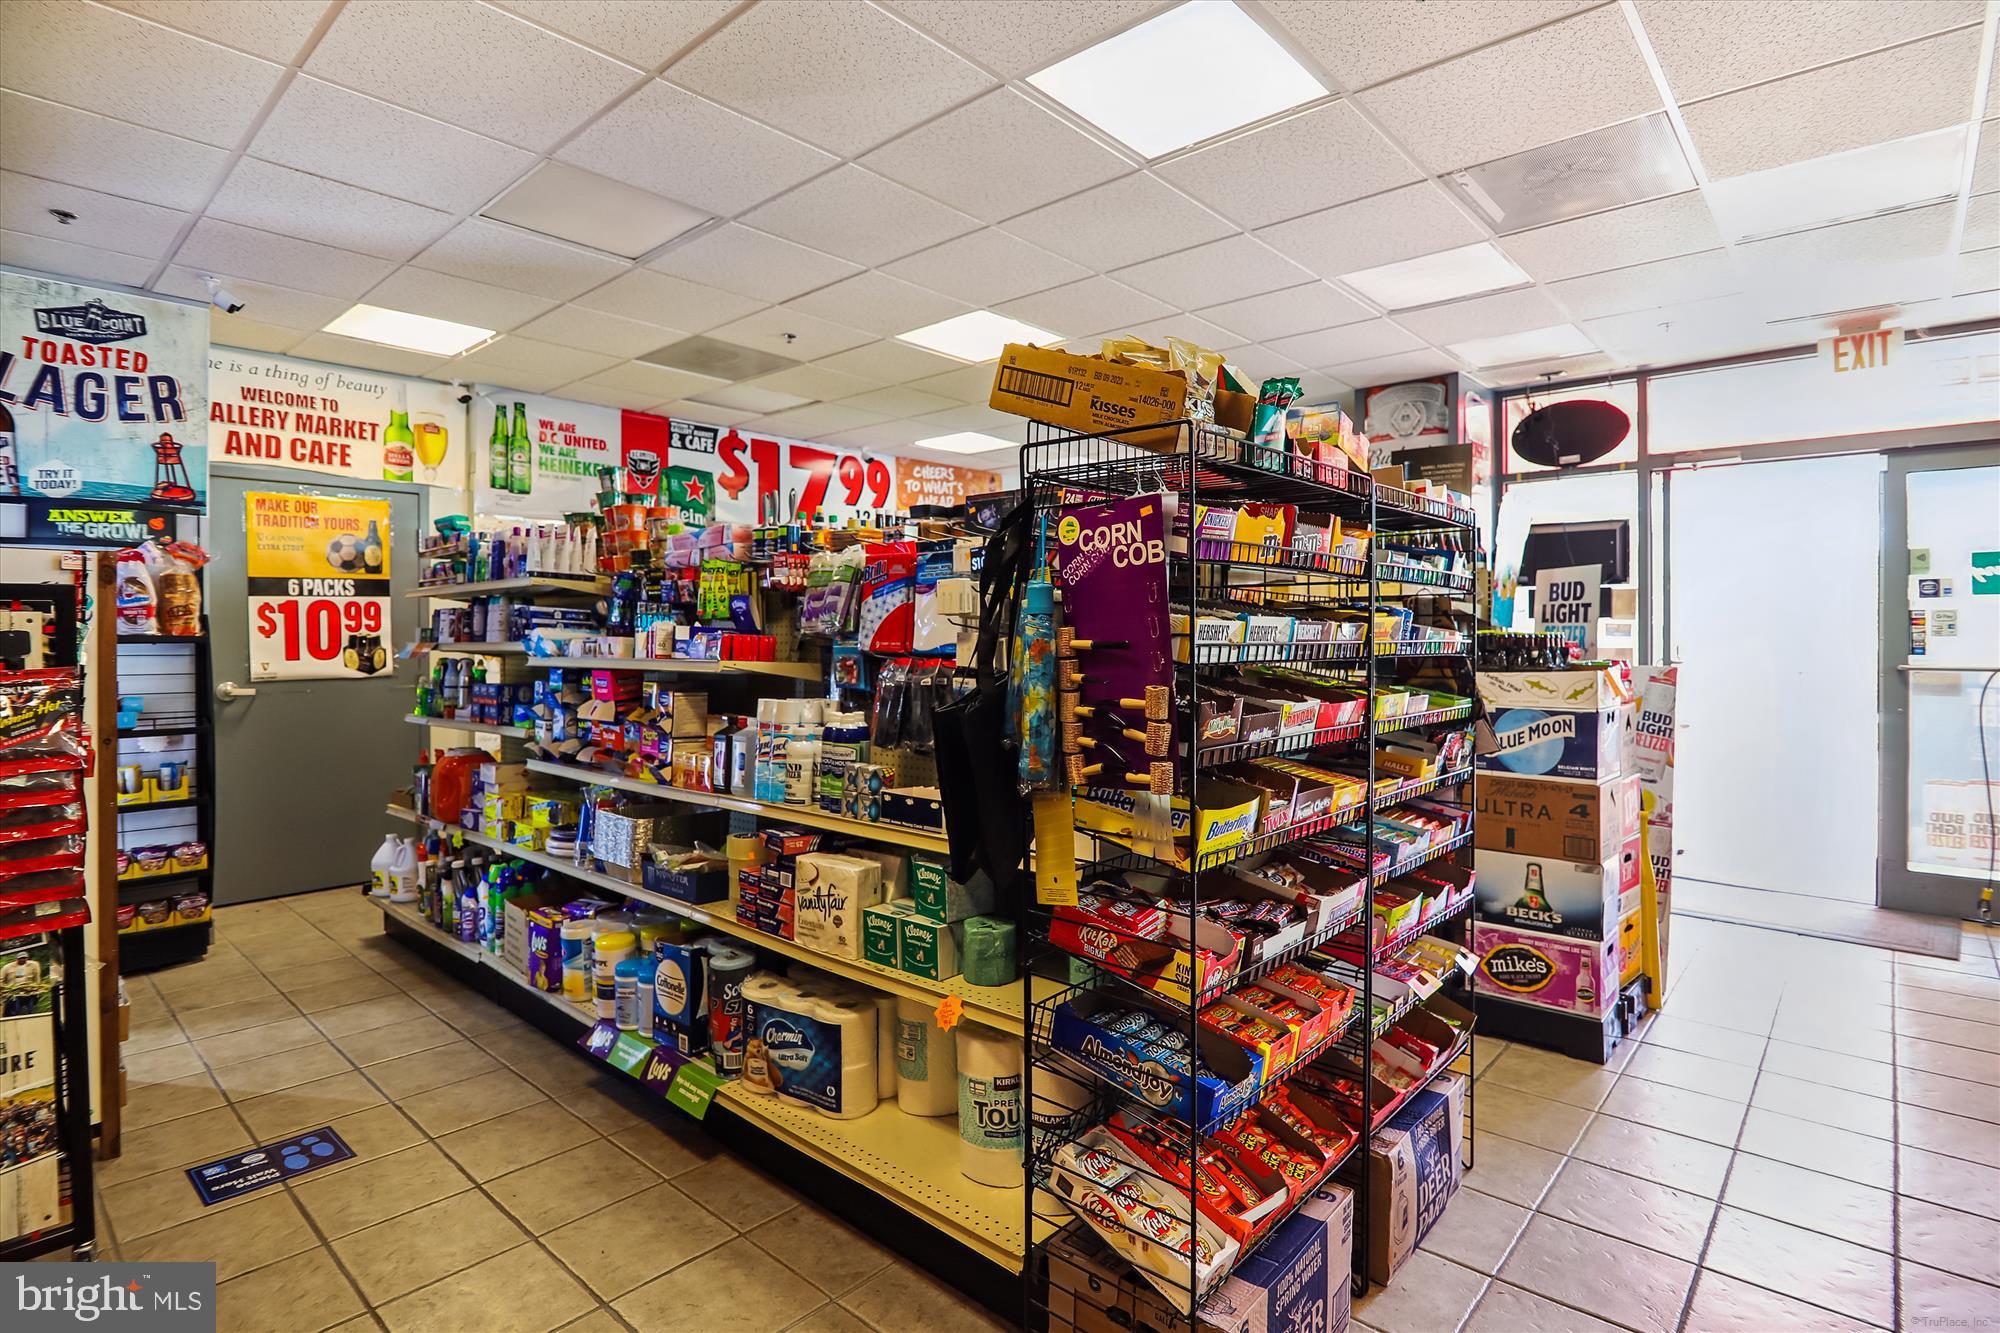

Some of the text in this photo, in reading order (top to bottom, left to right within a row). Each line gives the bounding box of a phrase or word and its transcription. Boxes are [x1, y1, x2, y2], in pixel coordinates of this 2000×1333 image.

[37, 311, 143, 333] BLUE POINT
[21, 335, 148, 373] TOASTED
[1832, 330, 1893, 373] EXIT
[0, 352, 188, 424] LAGER
[230, 360, 242, 372] is
[249, 366, 258, 375] a
[265, 364, 308, 387] thing
[315, 373, 333, 390] of
[336, 375, 388, 399] beauty
[241, 386, 339, 412] WELCOME TO
[296, 413, 379, 441] MARKET
[539, 419, 576, 433] WE ARE
[225, 431, 352, 467] AND CAFE
[539, 433, 608, 451] D.C. UNITED.
[539, 444, 577, 458] WE ARE
[671, 433, 714, 452] & CAFE
[38, 469, 73, 479] TRY IT
[912, 465, 955, 480] CHEERS
[34, 479, 77, 490] TODAY!
[904, 479, 964, 495] TO WHAT'S
[256, 499, 317, 513] MAKE OUR
[1065, 493, 1075, 504] 24
[48, 509, 136, 523] ANSWER
[256, 514, 363, 531] TRADITION YOURS.
[57, 522, 84, 536] THE
[1079, 519, 1142, 552] CORN
[1113, 540, 1165, 567] COB
[288, 579, 355, 596] 6 PACKS
[1550, 581, 1585, 601] BUD
[1541, 602, 1592, 623] LIGHT
[1198, 623, 1229, 640] HERSHEY'S
[1250, 625, 1278, 642] HERSHEY'S
[1642, 710, 1672, 727] BUD
[1500, 719, 1573, 750] LUE MOON
[1636, 721, 1673, 739] LIGHT
[1384, 760, 1411, 772] HALLS
[1476, 798, 1590, 821] ULTRA 4
[1652, 854, 1669, 868] UD
[917, 868, 942, 885] Kleenex
[867, 915, 893, 930] Kleenex
[1506, 906, 1562, 924] BECK'S
[905, 924, 932, 941] Kleenex
[1176, 962, 1191, 976] KIN
[1491, 956, 1547, 974] mike's
[656, 975, 686, 996] Cottonelle
[1175, 974, 1191, 986] SIZ
[747, 1005, 753, 1014] 6
[766, 1026, 803, 1046] Charmin
[647, 1056, 672, 1081] Luvs
[1081, 1035, 1174, 1099] Almond Joy
[210, 1177, 244, 1191] Here
[236, 1172, 280, 1188] Please
[1419, 1153, 1451, 1213] DEER
[1295, 1238, 1322, 1279] NATURAL
[1275, 1253, 1322, 1317] SPRING WATER
